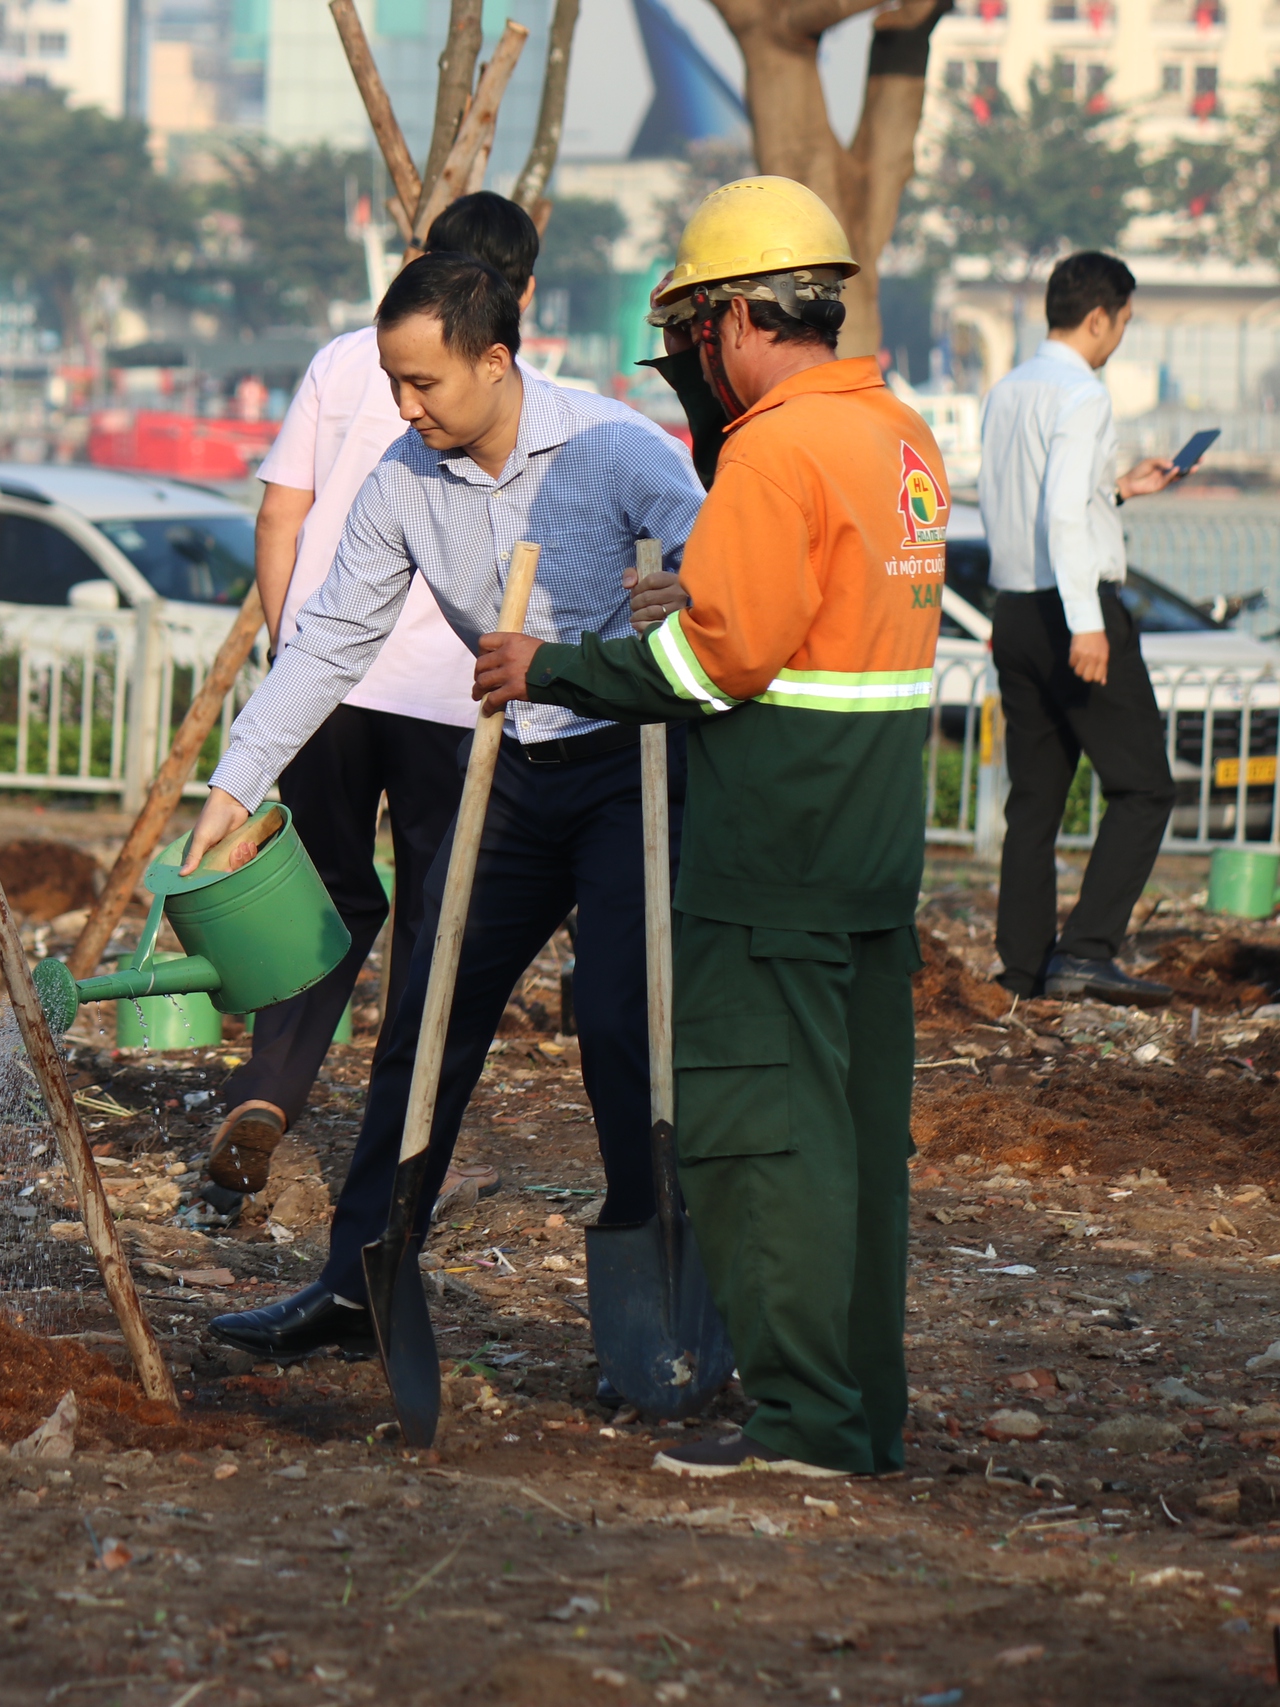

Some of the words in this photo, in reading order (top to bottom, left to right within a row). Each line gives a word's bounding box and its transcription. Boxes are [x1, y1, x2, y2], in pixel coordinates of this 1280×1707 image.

[913, 477, 929, 493] HL
[885, 556, 898, 576] VÌ
[899, 555, 923, 579] MỘT
